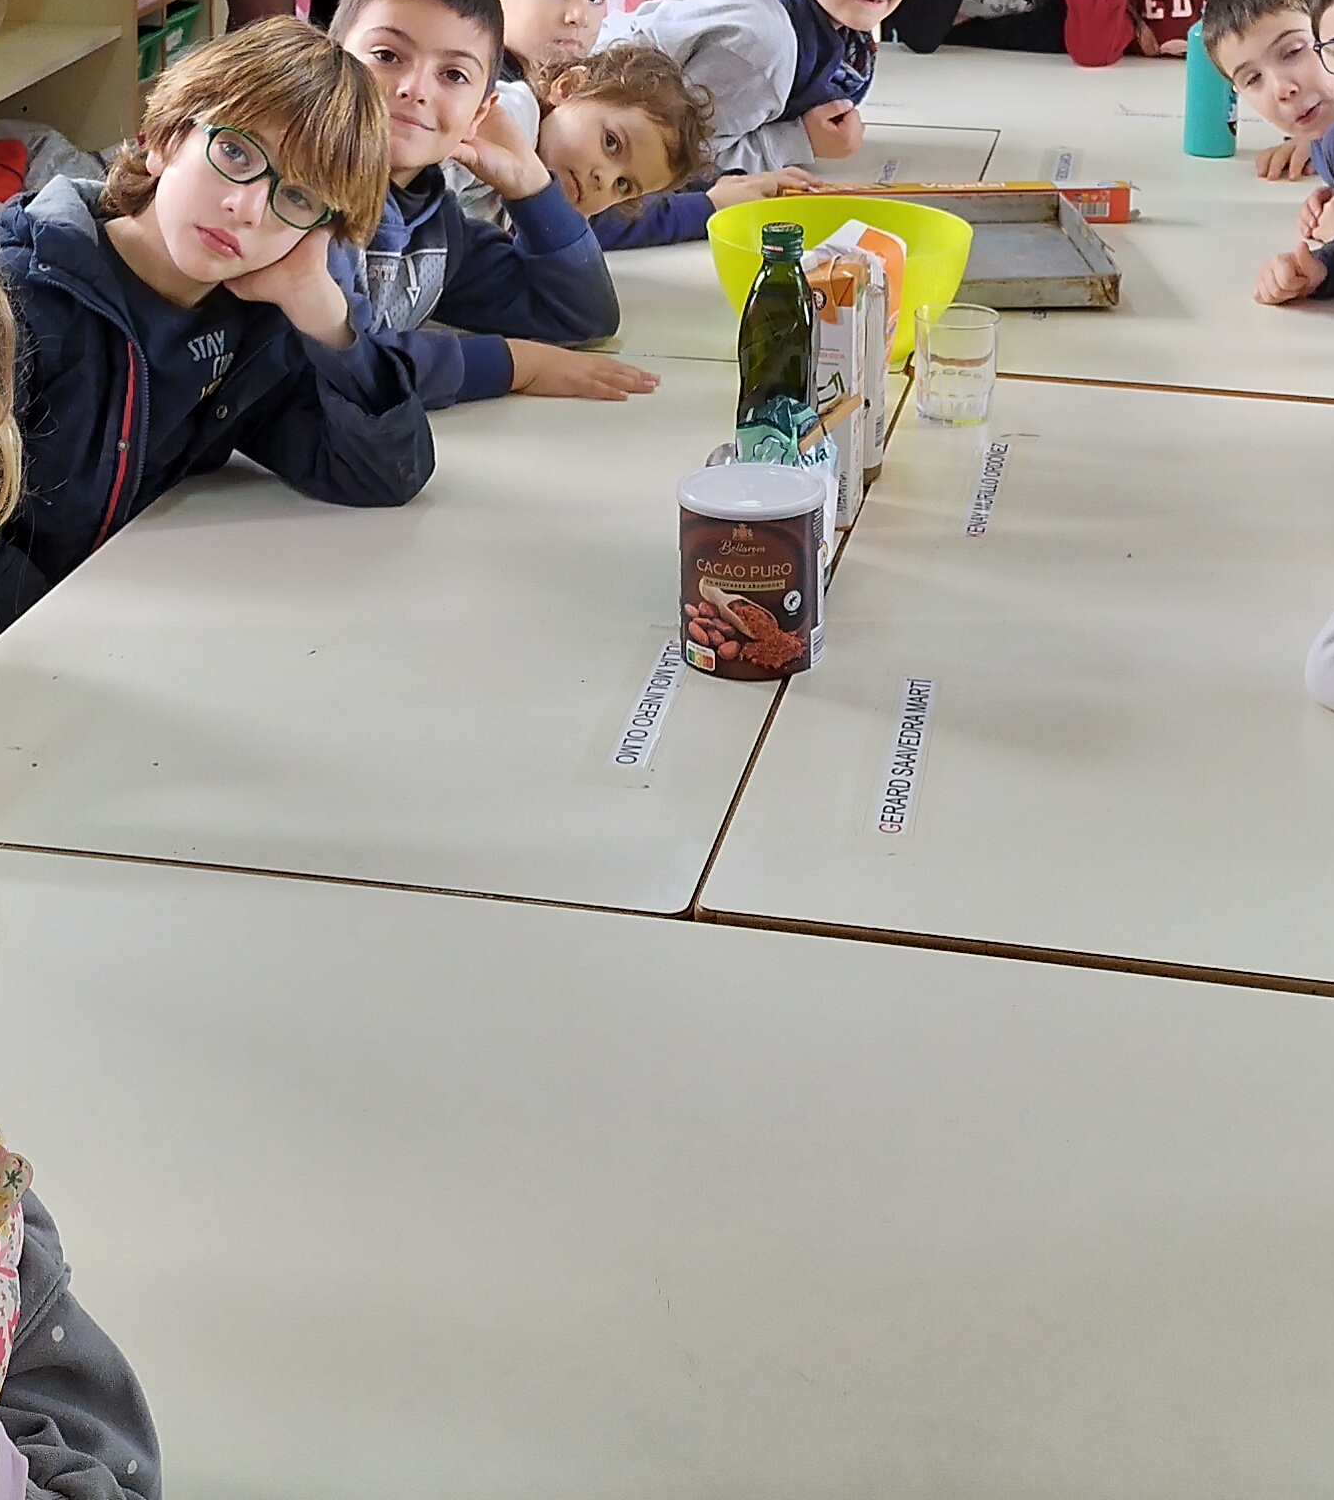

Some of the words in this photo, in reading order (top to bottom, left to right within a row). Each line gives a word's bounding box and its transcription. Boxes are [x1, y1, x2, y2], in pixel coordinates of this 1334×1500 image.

[187, 330, 224, 361] STAY
[696, 559, 746, 578] CACAO
[750, 562, 792, 578] PURO
[905, 678, 932, 713] MARTÍ
[615, 729, 648, 765] OLMO
[891, 714, 926, 777] SAAVEDRA
[879, 778, 911, 834] GERARD
